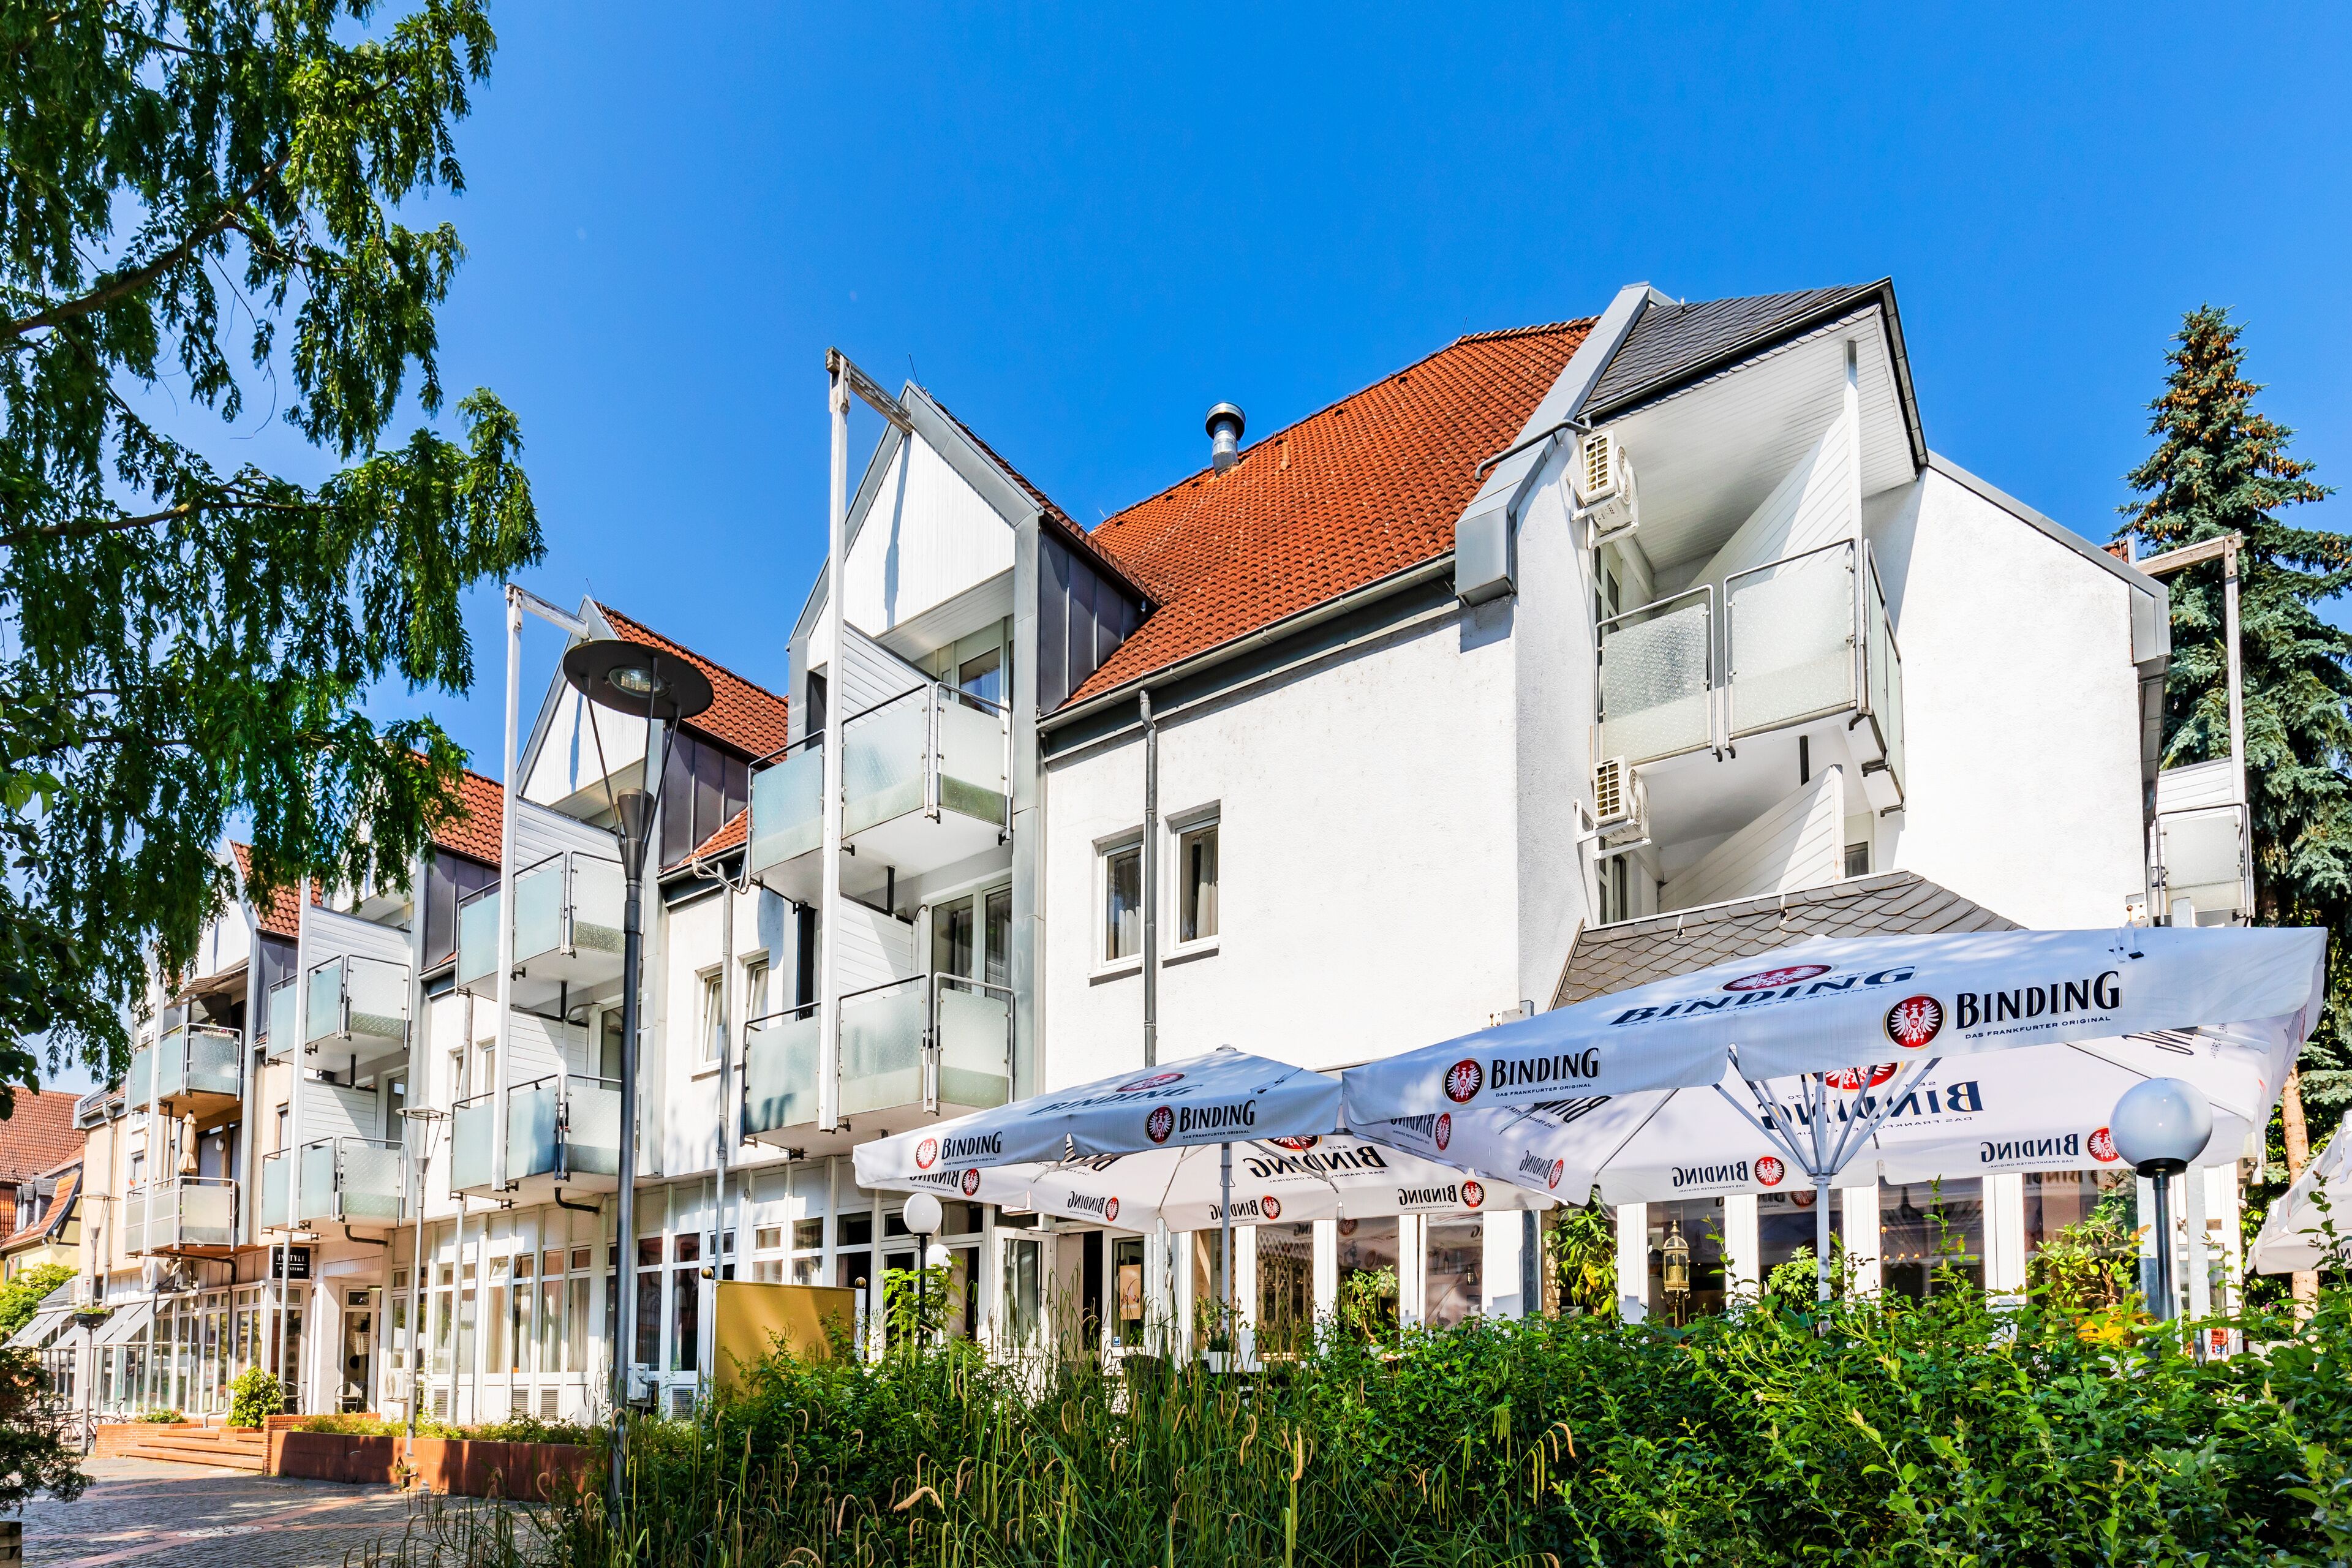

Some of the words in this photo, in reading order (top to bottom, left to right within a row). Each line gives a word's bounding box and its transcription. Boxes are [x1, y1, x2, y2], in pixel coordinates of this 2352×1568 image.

[1608, 966, 1916, 1025] BINDING
[1956, 970, 2120, 1030] BINDING
[1987, 1022, 2058, 1036] FRANKFURTER
[2062, 1016, 2111, 1027] ORIGINAL
[1490, 1047, 1600, 1090] BINDING
[1510, 1087, 1558, 1096] FRANKFURTER
[1179, 1099, 1256, 1133] BINDING
[941, 1131, 1003, 1159] BINDING
